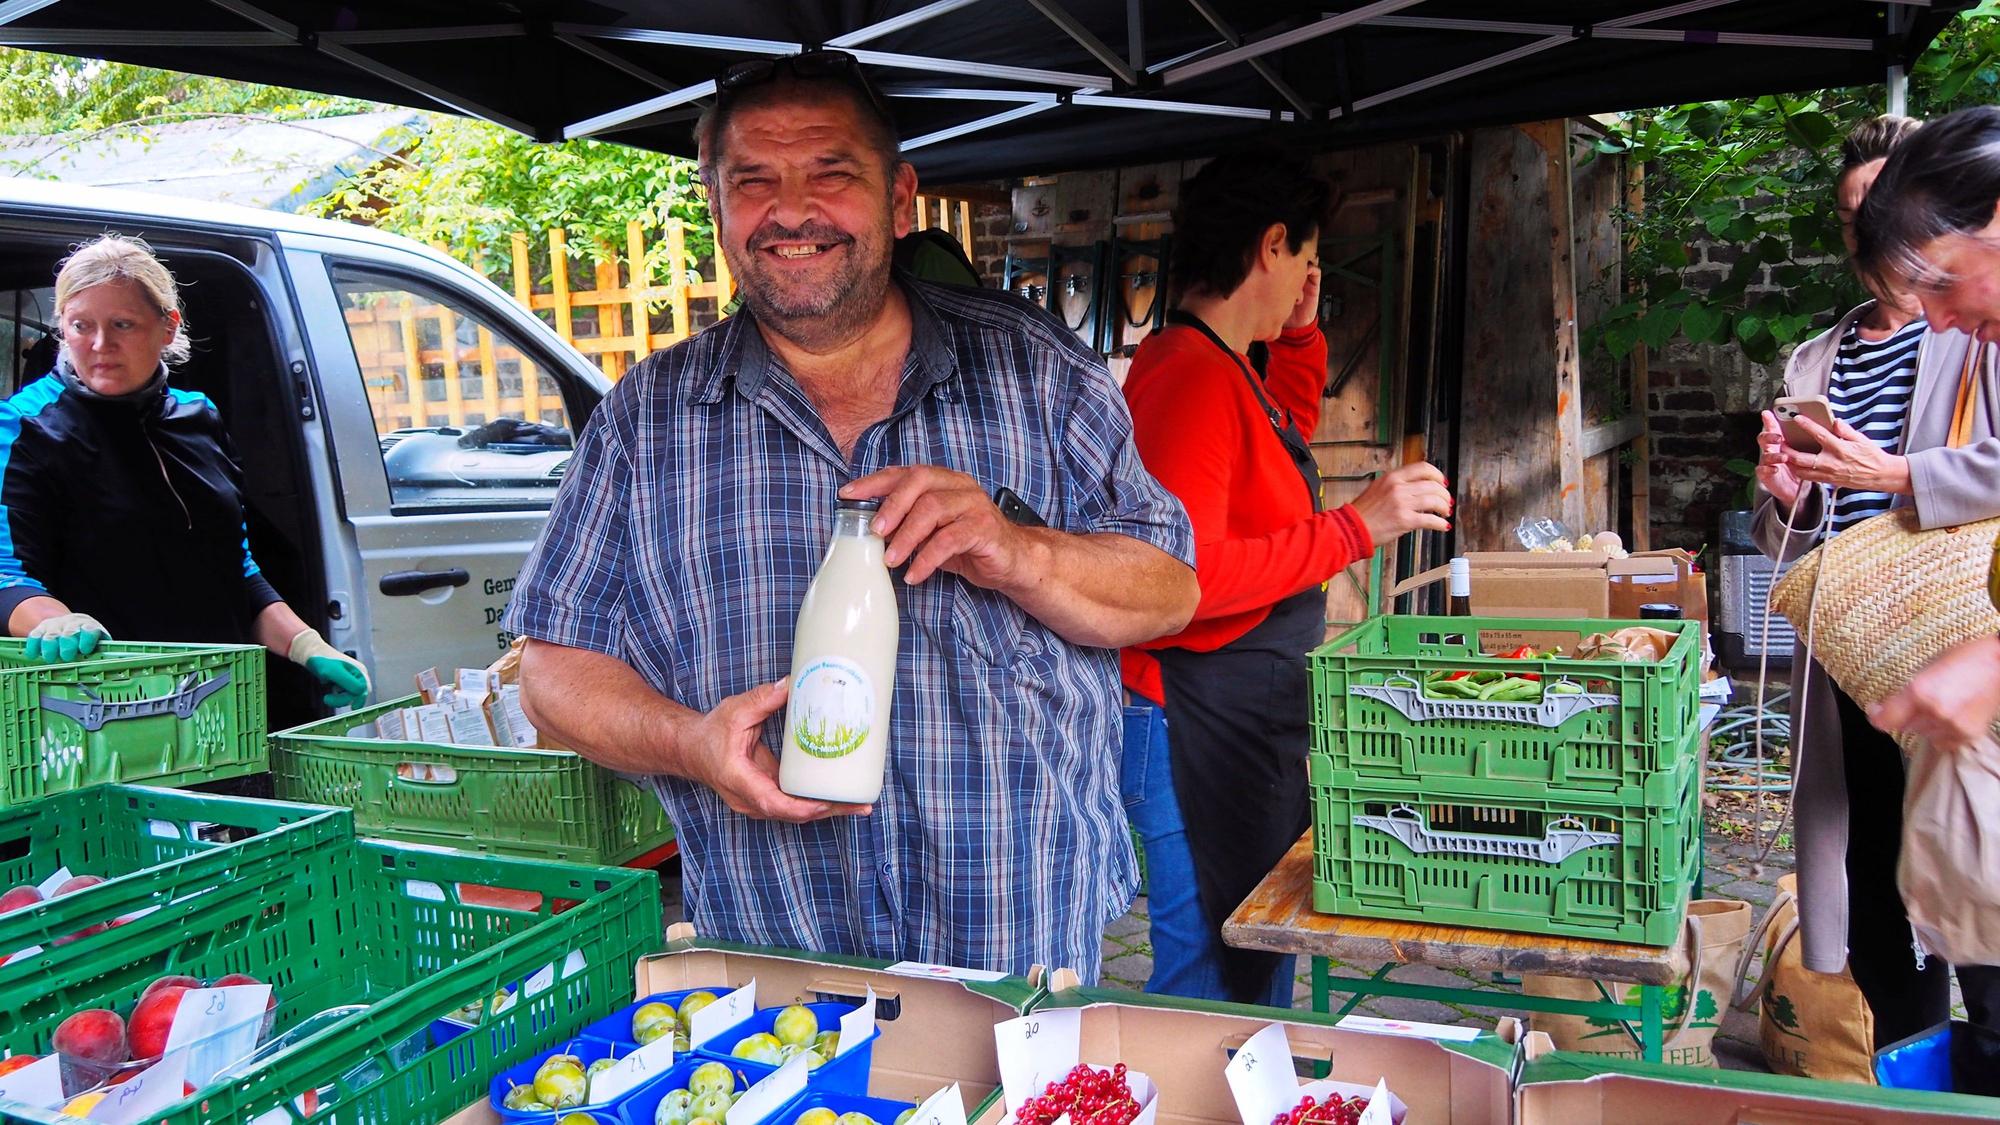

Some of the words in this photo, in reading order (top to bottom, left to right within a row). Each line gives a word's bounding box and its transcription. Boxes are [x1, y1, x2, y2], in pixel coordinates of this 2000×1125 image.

[484, 604, 507, 624] Da
[497, 631, 517, 650] 53
[1025, 1022, 1039, 1039] 20
[1242, 1052, 1258, 1071] 22
